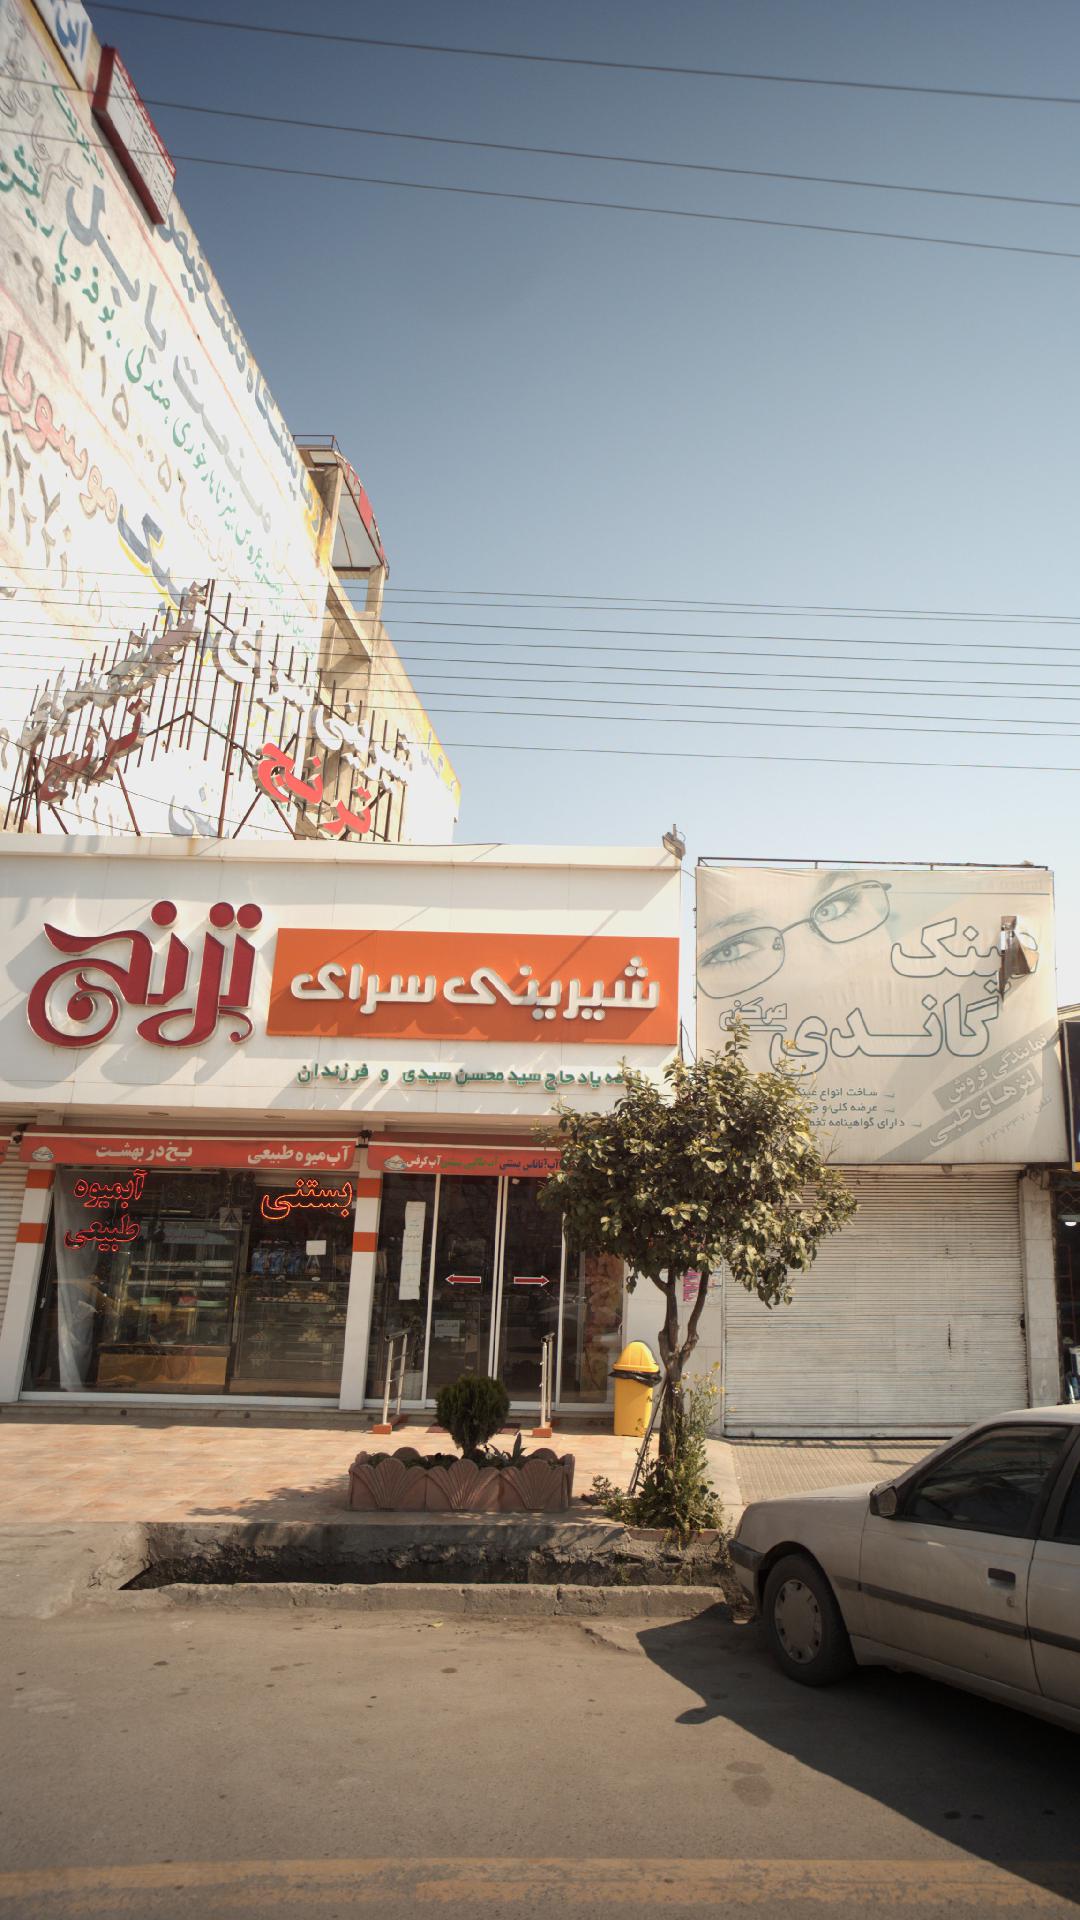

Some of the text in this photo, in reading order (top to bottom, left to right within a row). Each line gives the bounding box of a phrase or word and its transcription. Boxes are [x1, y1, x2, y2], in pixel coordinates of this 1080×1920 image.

[0, 329, 118, 525] موسویا
[252, 742, 372, 836] ترنج
[27, 900, 264, 1049] ترنج
[290, 955, 660, 1021] شیرینی سرای
[768, 992, 1003, 1077] گاندی
[296, 1062, 370, 1087] فرزندان
[379, 1068, 390, 1085] و
[402, 1068, 452, 1087] سیدی
[455, 1067, 505, 1087] محسن
[507, 1069, 542, 1088] سید
[543, 1069, 576, 1092] حاج
[577, 1070, 602, 1089] یاد
[948, 1064, 988, 1103] فروش
[819, 1087, 843, 1102] انواع
[846, 1087, 878, 1098] ساخت
[830, 1102, 848, 1114] کلی
[849, 1104, 878, 1115] عرضه
[828, 1116, 875, 1130] گواهینامه
[876, 1117, 906, 1130] دارای
[929, 1107, 972, 1148] طبی
[95, 1142, 145, 1163] بهشت
[247, 1144, 294, 1165] طبیعی
[260, 1177, 354, 1221] بستنی
[63, 1213, 141, 1251] طبیعی
